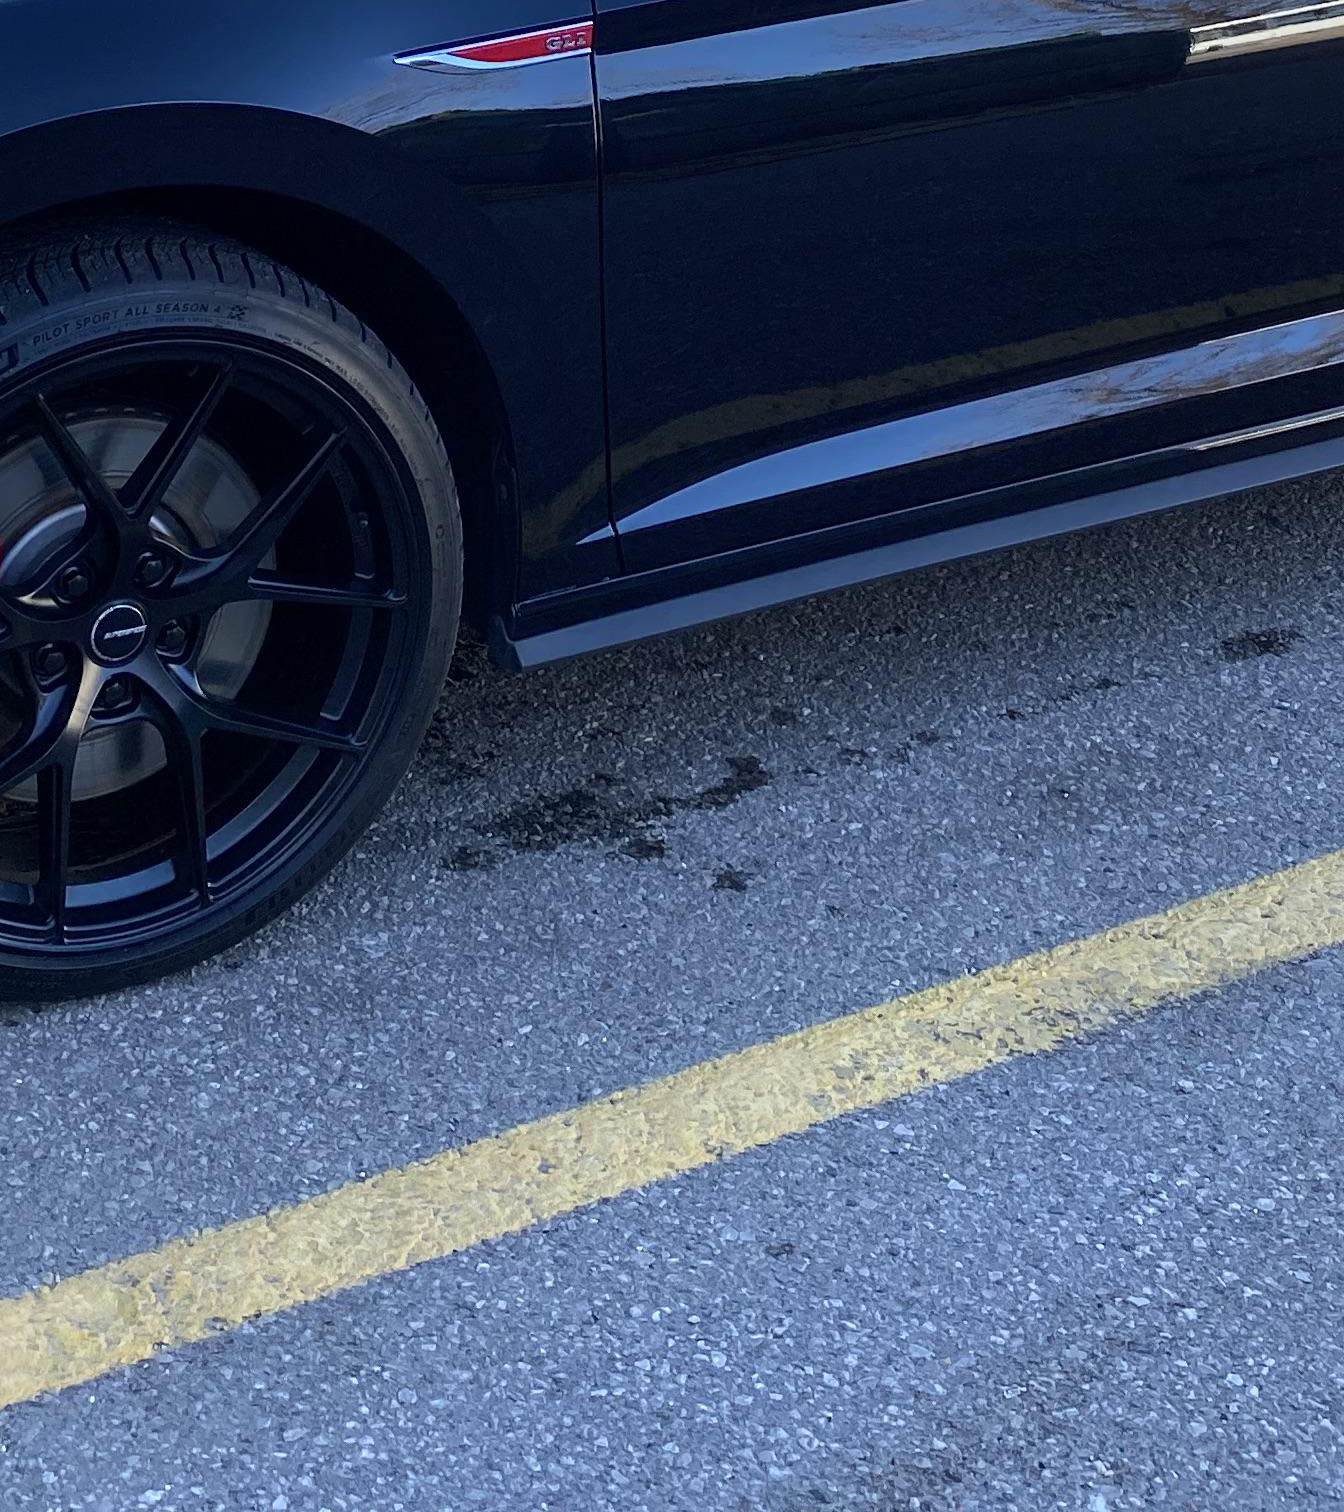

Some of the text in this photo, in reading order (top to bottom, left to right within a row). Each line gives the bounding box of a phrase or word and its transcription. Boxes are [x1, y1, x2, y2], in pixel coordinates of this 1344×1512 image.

[545, 32, 588, 51] GLI
[32, 322, 71, 347] PILOT
[75, 309, 119, 330] SPORT
[124, 305, 149, 318] ALL
[156, 302, 209, 314] SEASON
